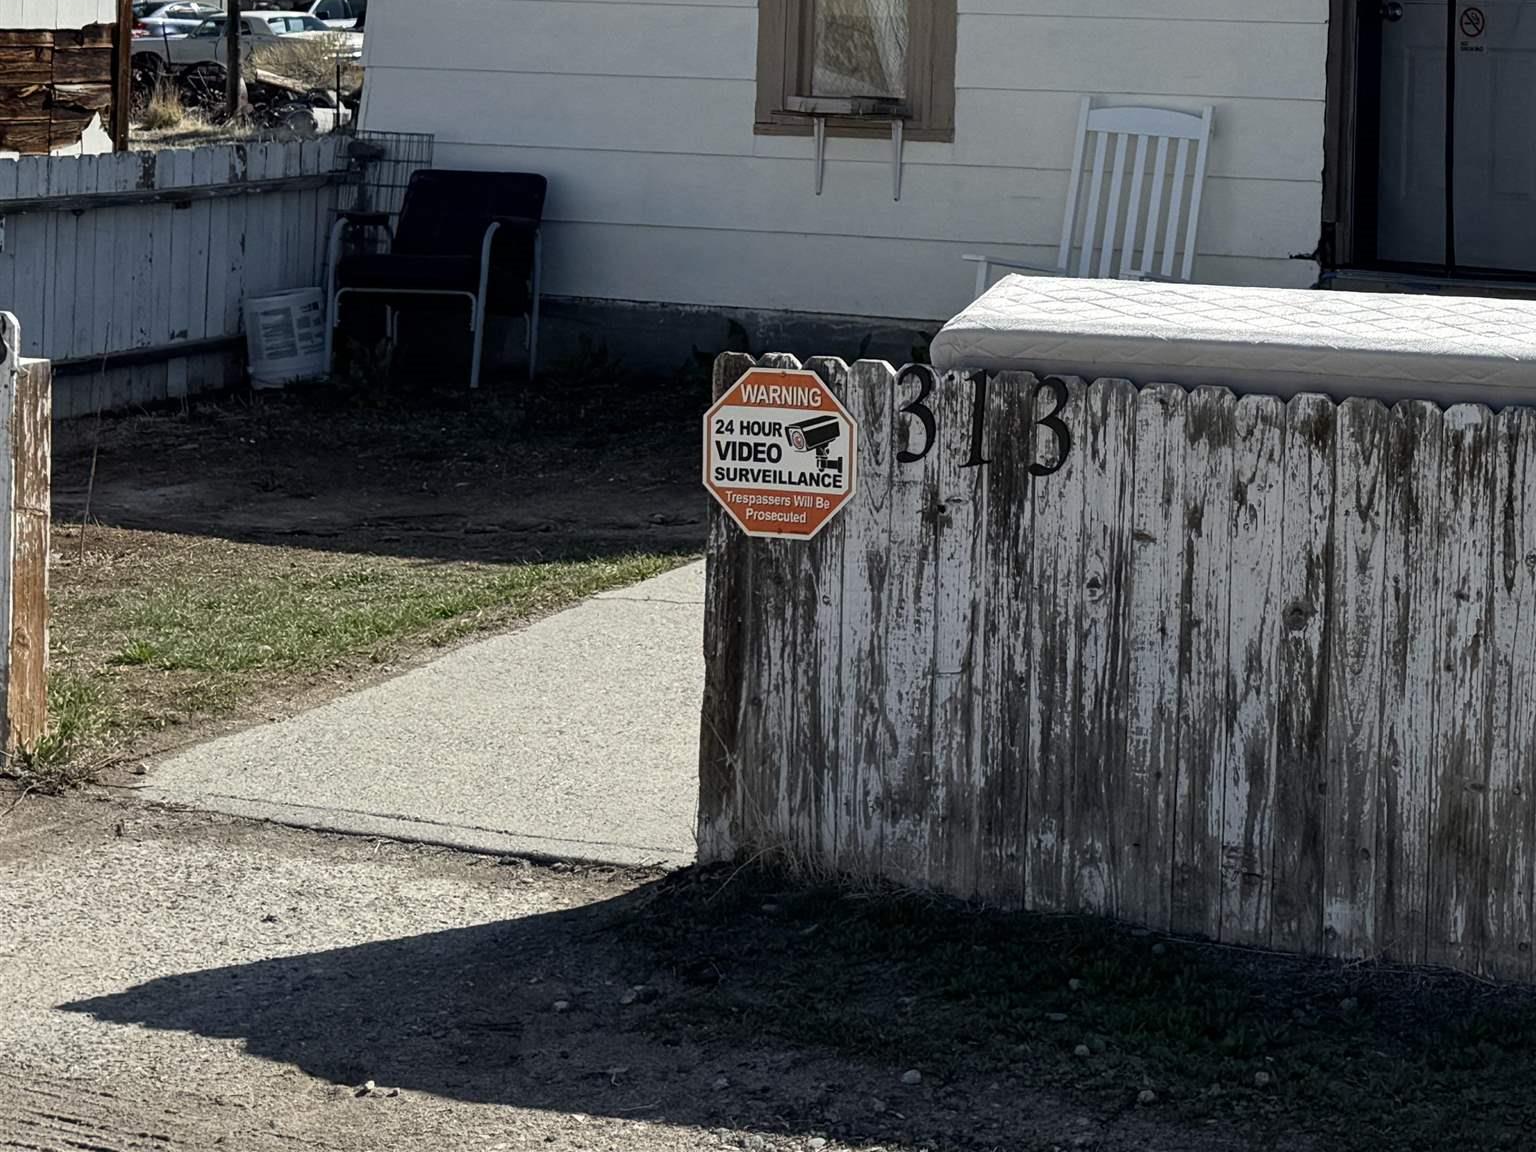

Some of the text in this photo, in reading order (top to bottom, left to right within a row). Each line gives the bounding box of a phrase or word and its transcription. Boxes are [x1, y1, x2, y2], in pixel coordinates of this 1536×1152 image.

[741, 383, 822, 407] WARNING
[715, 419, 782, 437] 24 HOUR
[896, 364, 1071, 476] 313
[715, 440, 782, 464] VIDEO
[714, 466, 843, 489] SURVEILLANCE
[725, 490, 830, 510] Trespassers Will Be
[745, 508, 807, 524] Prosecuted
